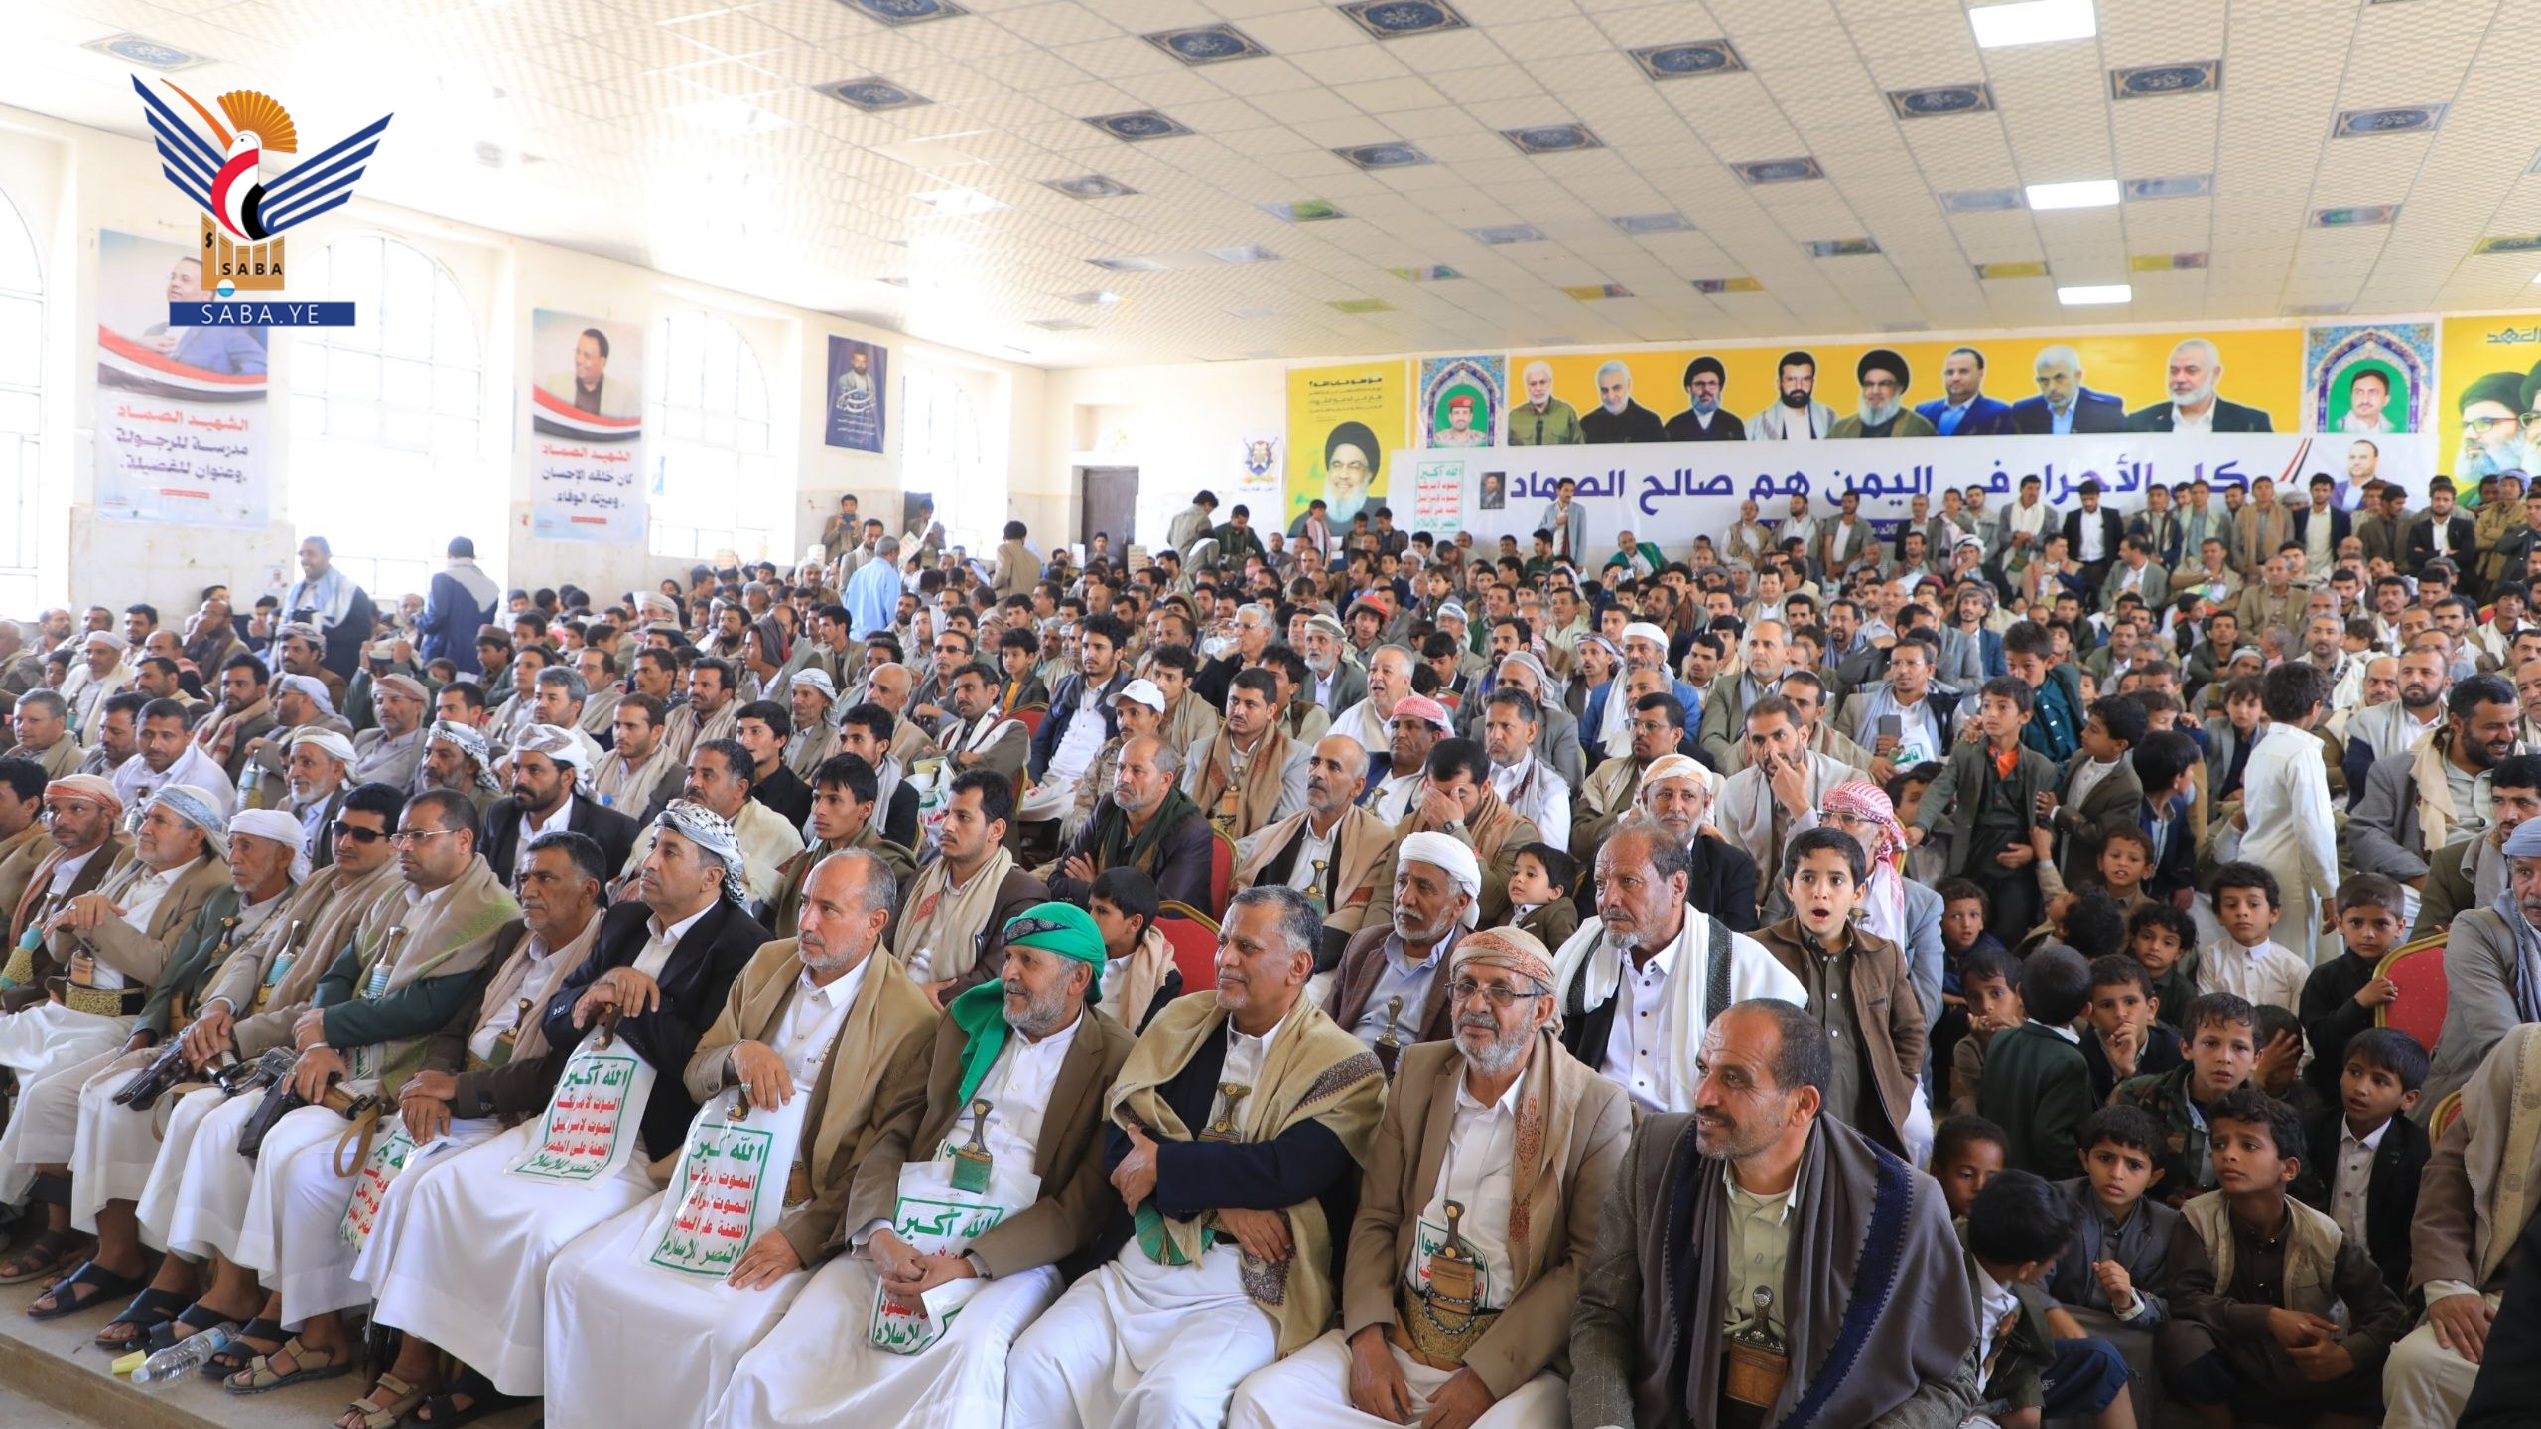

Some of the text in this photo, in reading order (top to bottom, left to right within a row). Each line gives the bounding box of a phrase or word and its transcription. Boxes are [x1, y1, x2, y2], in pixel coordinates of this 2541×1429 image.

[117, 404, 248, 431] الشهيد الصماد
[116, 426, 248, 457] مدرسة للرجولة
[591, 450, 630, 462] الشهيد
[1640, 468, 1734, 516] صالح
[1750, 470, 1810, 501] هم
[563, 1060, 628, 1092] الله أكبر
[730, 1136, 764, 1162] الله
[718, 1173, 756, 1190] الموت
[713, 1196, 752, 1215] الموت
[896, 1207, 993, 1241] الله أكبر
